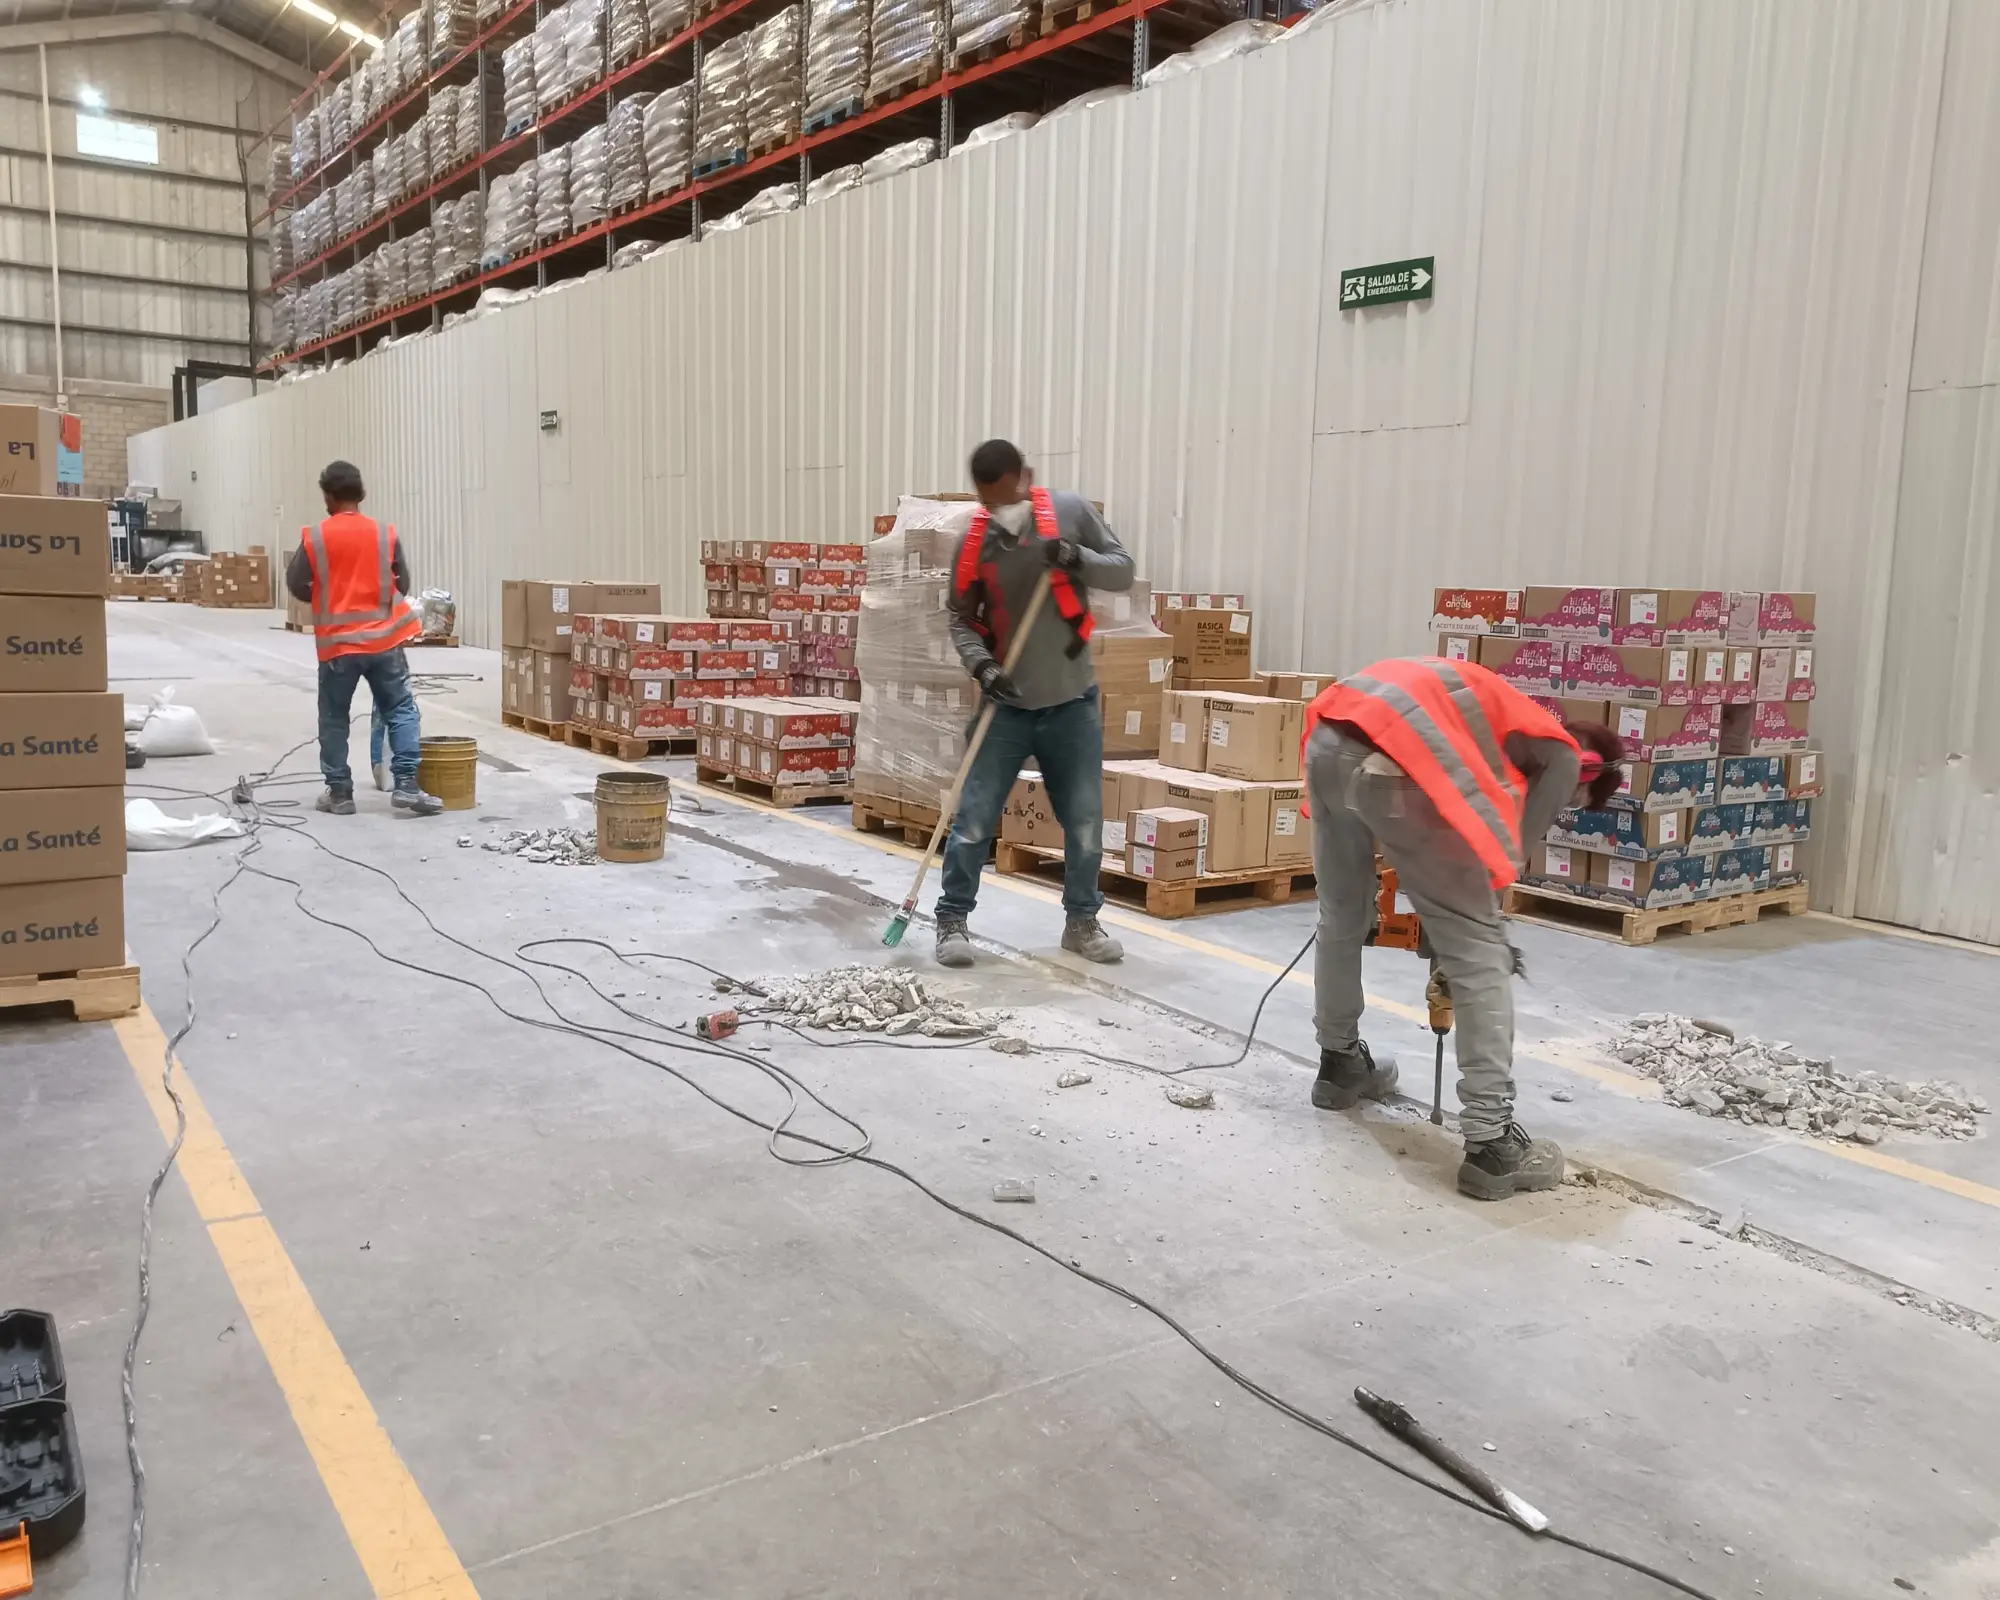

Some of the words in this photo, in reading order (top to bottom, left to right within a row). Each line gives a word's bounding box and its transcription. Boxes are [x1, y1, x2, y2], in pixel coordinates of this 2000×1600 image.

[1367, 273, 1396, 288] SALIDA
[1398, 271, 1410, 283] DE
[1366, 283, 1409, 297] EMERGENCIA
[8, 441, 35, 460] La
[50, 535, 80, 555] La
[1562, 604, 1596, 616] angels
[1197, 622, 1224, 630] BASICA
[6, 635, 83, 656] Santé
[1515, 656, 1548, 668] angels
[1583, 661, 1617, 674] angels
[22, 733, 99, 756] Santé
[0, 838, 19, 851] a
[26, 825, 101, 850] Santé
[24, 916, 99, 943] Santé
